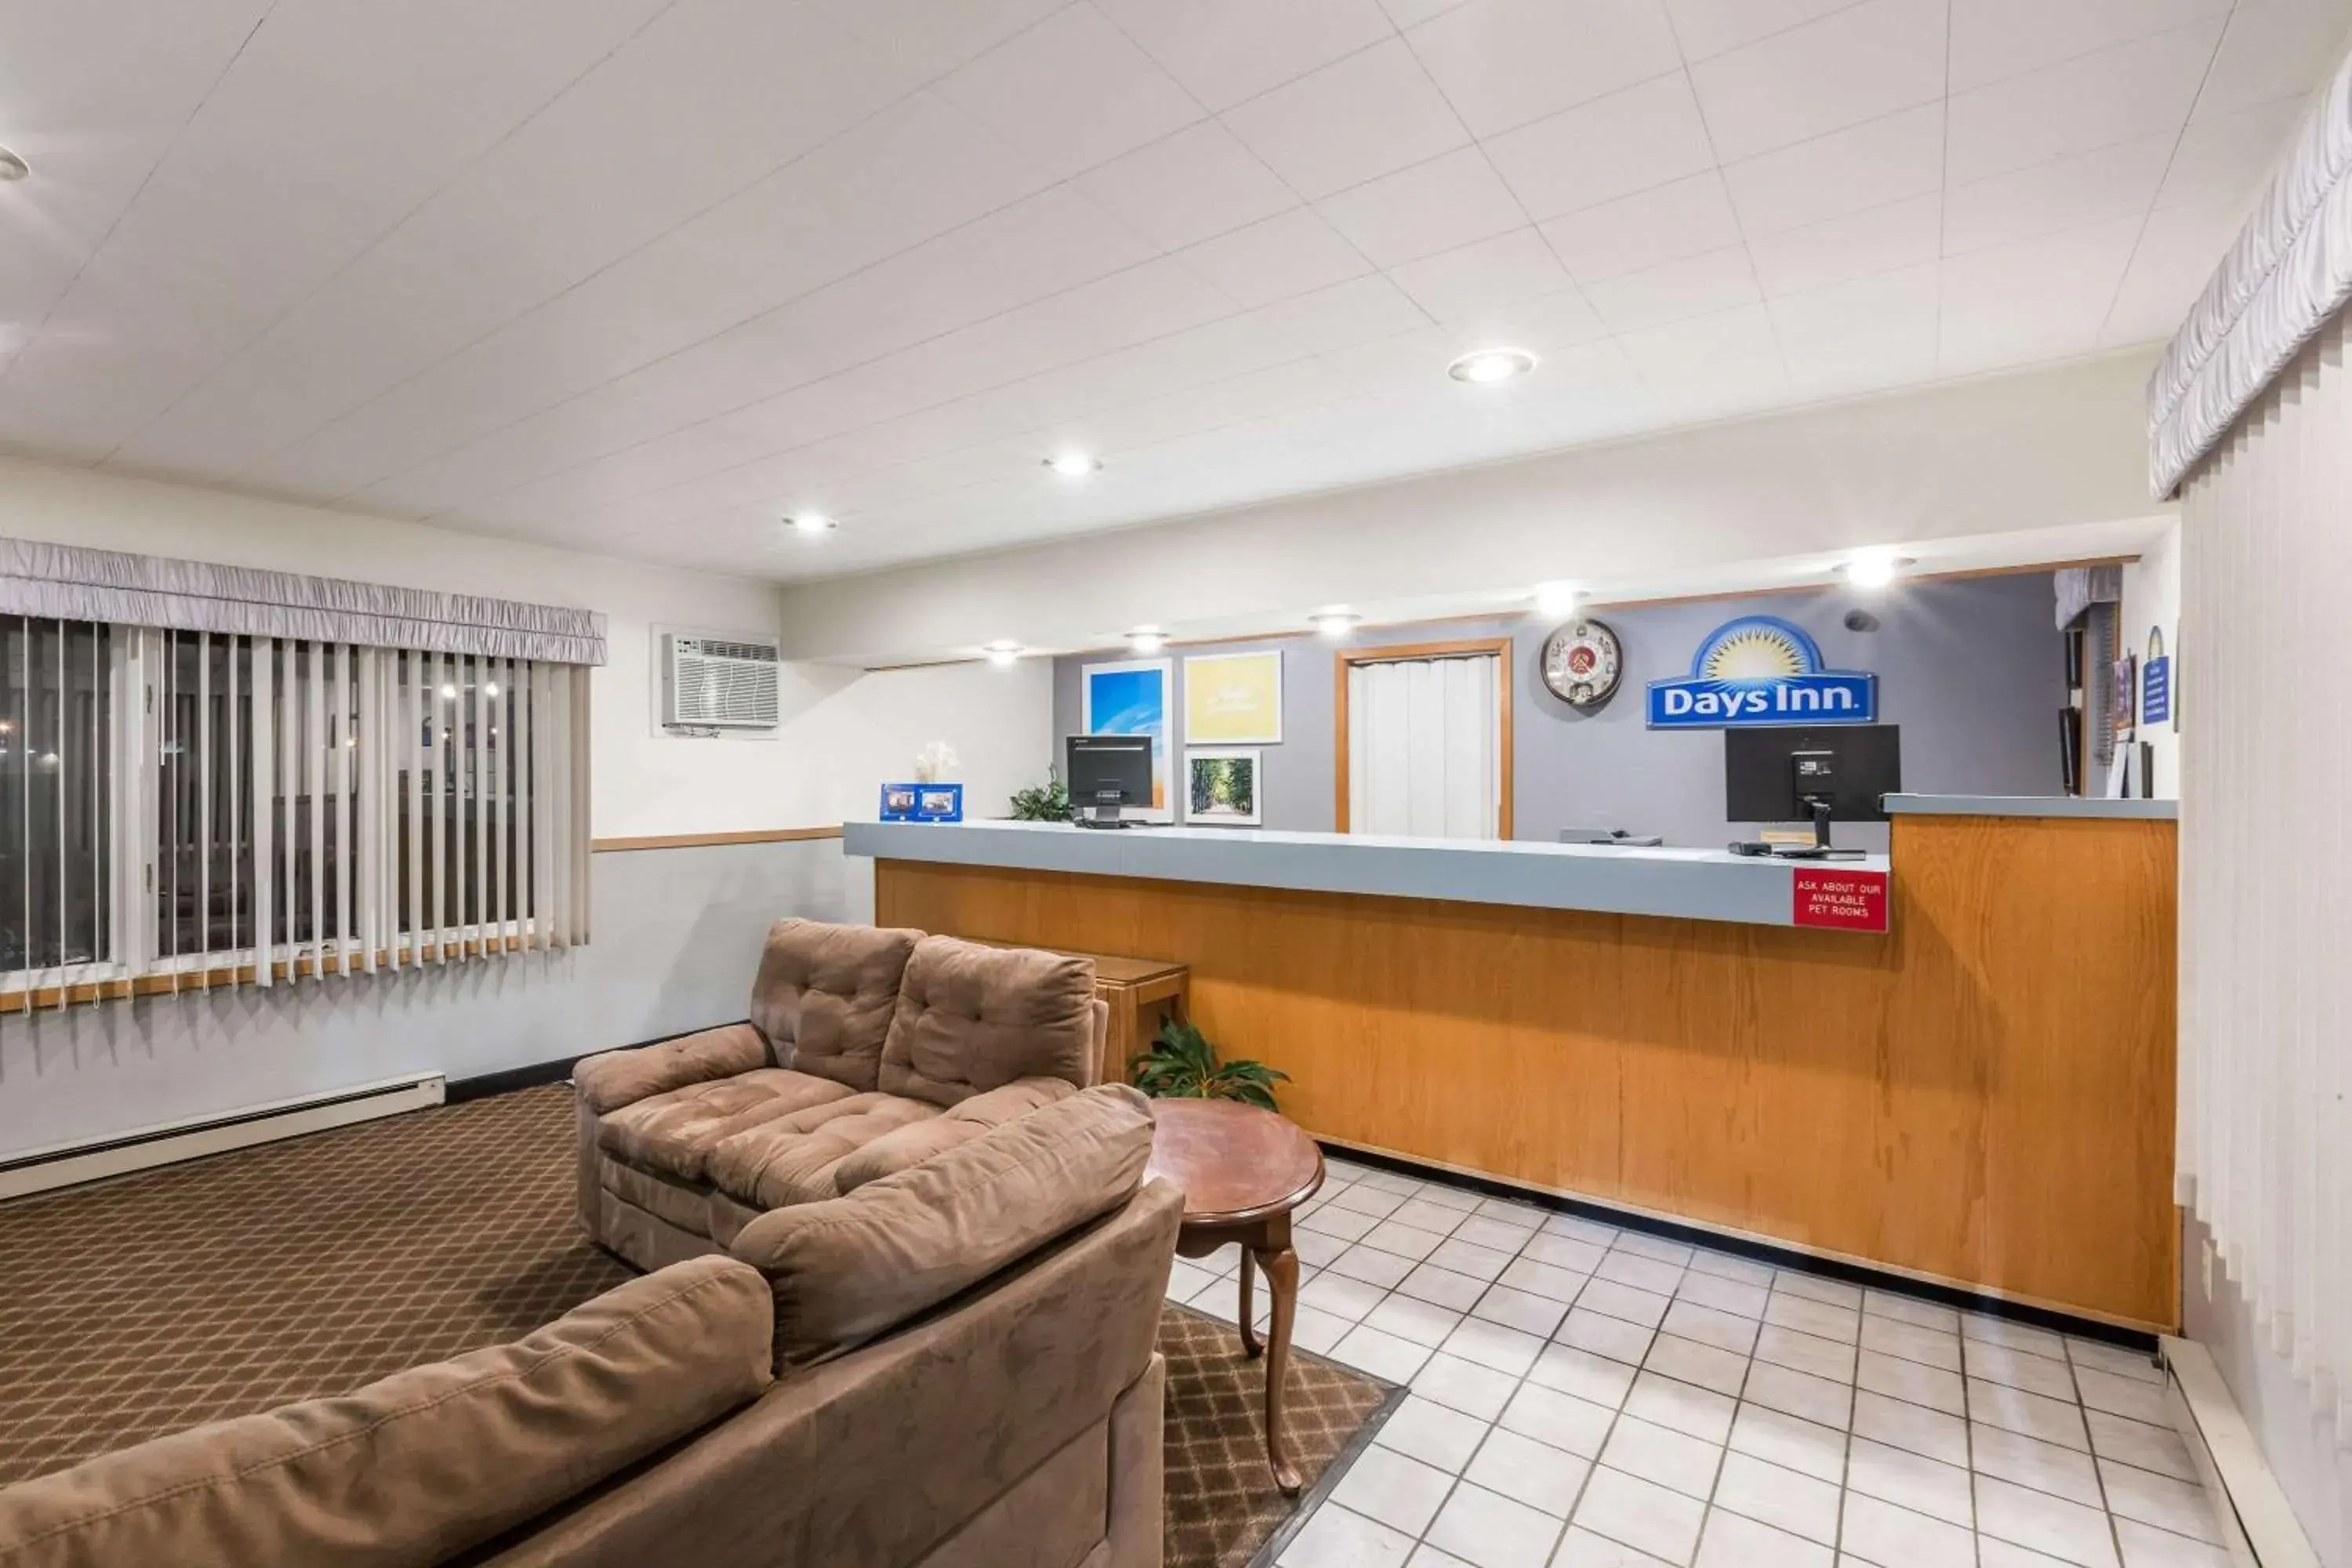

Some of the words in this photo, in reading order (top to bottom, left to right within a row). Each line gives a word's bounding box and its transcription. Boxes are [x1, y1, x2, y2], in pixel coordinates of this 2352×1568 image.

[1665, 688, 1768, 717] Days
[1798, 880, 1817, 891] ASK
[1822, 882, 1854, 892] ABOUT
[1859, 884, 1881, 895] OUR
[1811, 894, 1866, 906] AVAILABLE
[1809, 904, 1827, 914] PET
[1832, 906, 1868, 918] ROOMS
